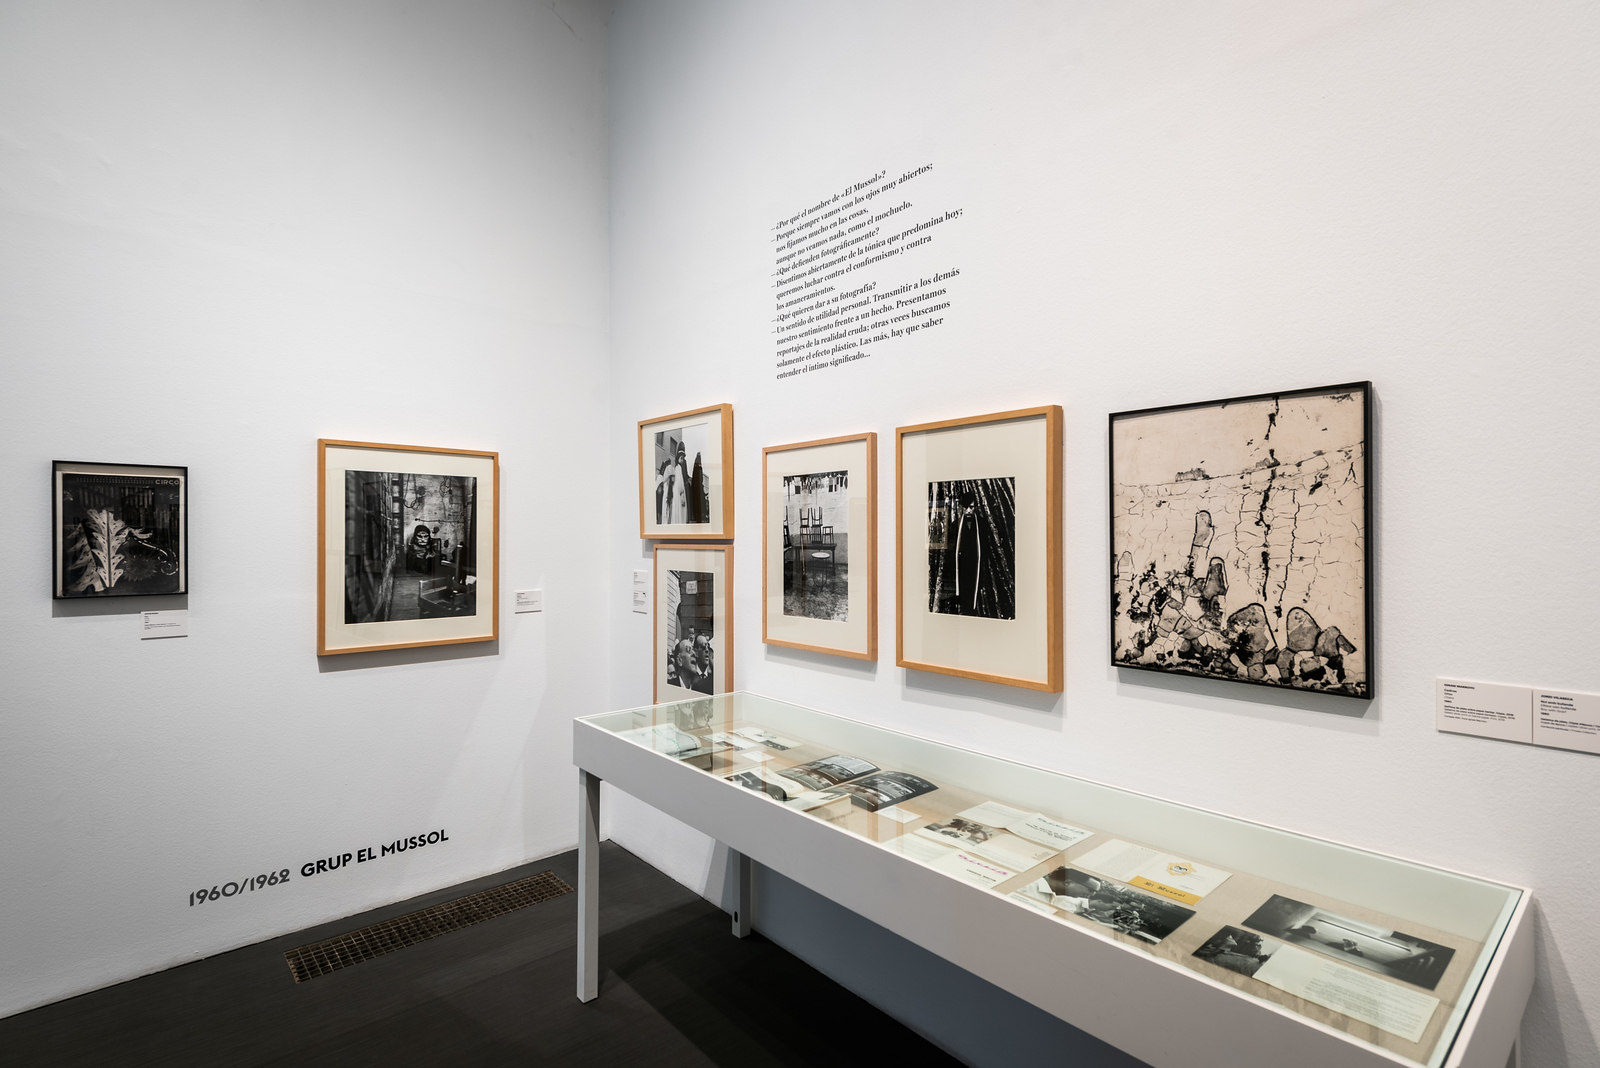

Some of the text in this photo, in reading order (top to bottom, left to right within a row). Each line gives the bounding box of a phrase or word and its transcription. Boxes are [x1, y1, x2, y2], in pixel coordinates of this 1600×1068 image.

[790, 212, 800, 225] qué
[801, 208, 807, 218] el
[808, 199, 831, 215] nombre
[832, 194, 840, 203] de
[797, 217, 820, 232] siempre
[821, 207, 840, 220] vamos
[842, 201, 853, 211] con
[855, 195, 864, 205] los
[866, 188, 880, 200] ojos
[882, 180, 897, 192] muy
[898, 163, 933, 184] abiertos;
[776, 201, 913, 265] aunque no veamos nada, como el mochuelo.
[776, 245, 786, 253] nos
[787, 235, 807, 249] fijamos
[809, 225, 829, 239] mucho
[830, 221, 837, 229] en
[839, 217, 847, 225] las
[792, 254, 820, 270] defienden
[821, 227, 879, 257] fotográficamente?
[808, 255, 847, 275] abiertamente
[848, 250, 856, 259] de
[858, 247, 864, 256] la
[865, 240, 886, 253] tónica
[887, 234, 900, 245] que
[902, 216, 943, 240] predomina
[945, 208, 963, 221] hoy;
[776, 235, 932, 300] queremos luchar contra el conformismo y contra
[777, 334, 798, 345] nuestro
[799, 323, 833, 338] sentimiento
[835, 317, 854, 328] frente
[861, 312, 870, 320] un
[871, 304, 894, 316] hecho.
[896, 288, 946, 308] Presentamos
[785, 286, 836, 307] amaneramientos.
[786, 318, 806, 330] sentido
[807, 315, 815, 324] de
[816, 306, 839, 321] utilidad
[841, 296, 871, 315] personal.
[873, 283, 912, 302] Transmitir
[920, 278, 932, 287] los
[933, 267, 960, 283] demás
[792, 305, 814, 318] quieren
[815, 301, 825, 309] dar
[831, 296, 839, 304] su
[840, 281, 876, 301] fotografía?
[777, 301, 950, 357] reportajes de la realidad cruda; otras veces buscamos
[777, 318, 943, 368] solamente el efecto plástico. Las más, hay que saber
[777, 368, 801, 379] entender
[802, 365, 807, 373] el
[189, 829, 449, 907] 1960/1962 GRUP EL MUSSOL
